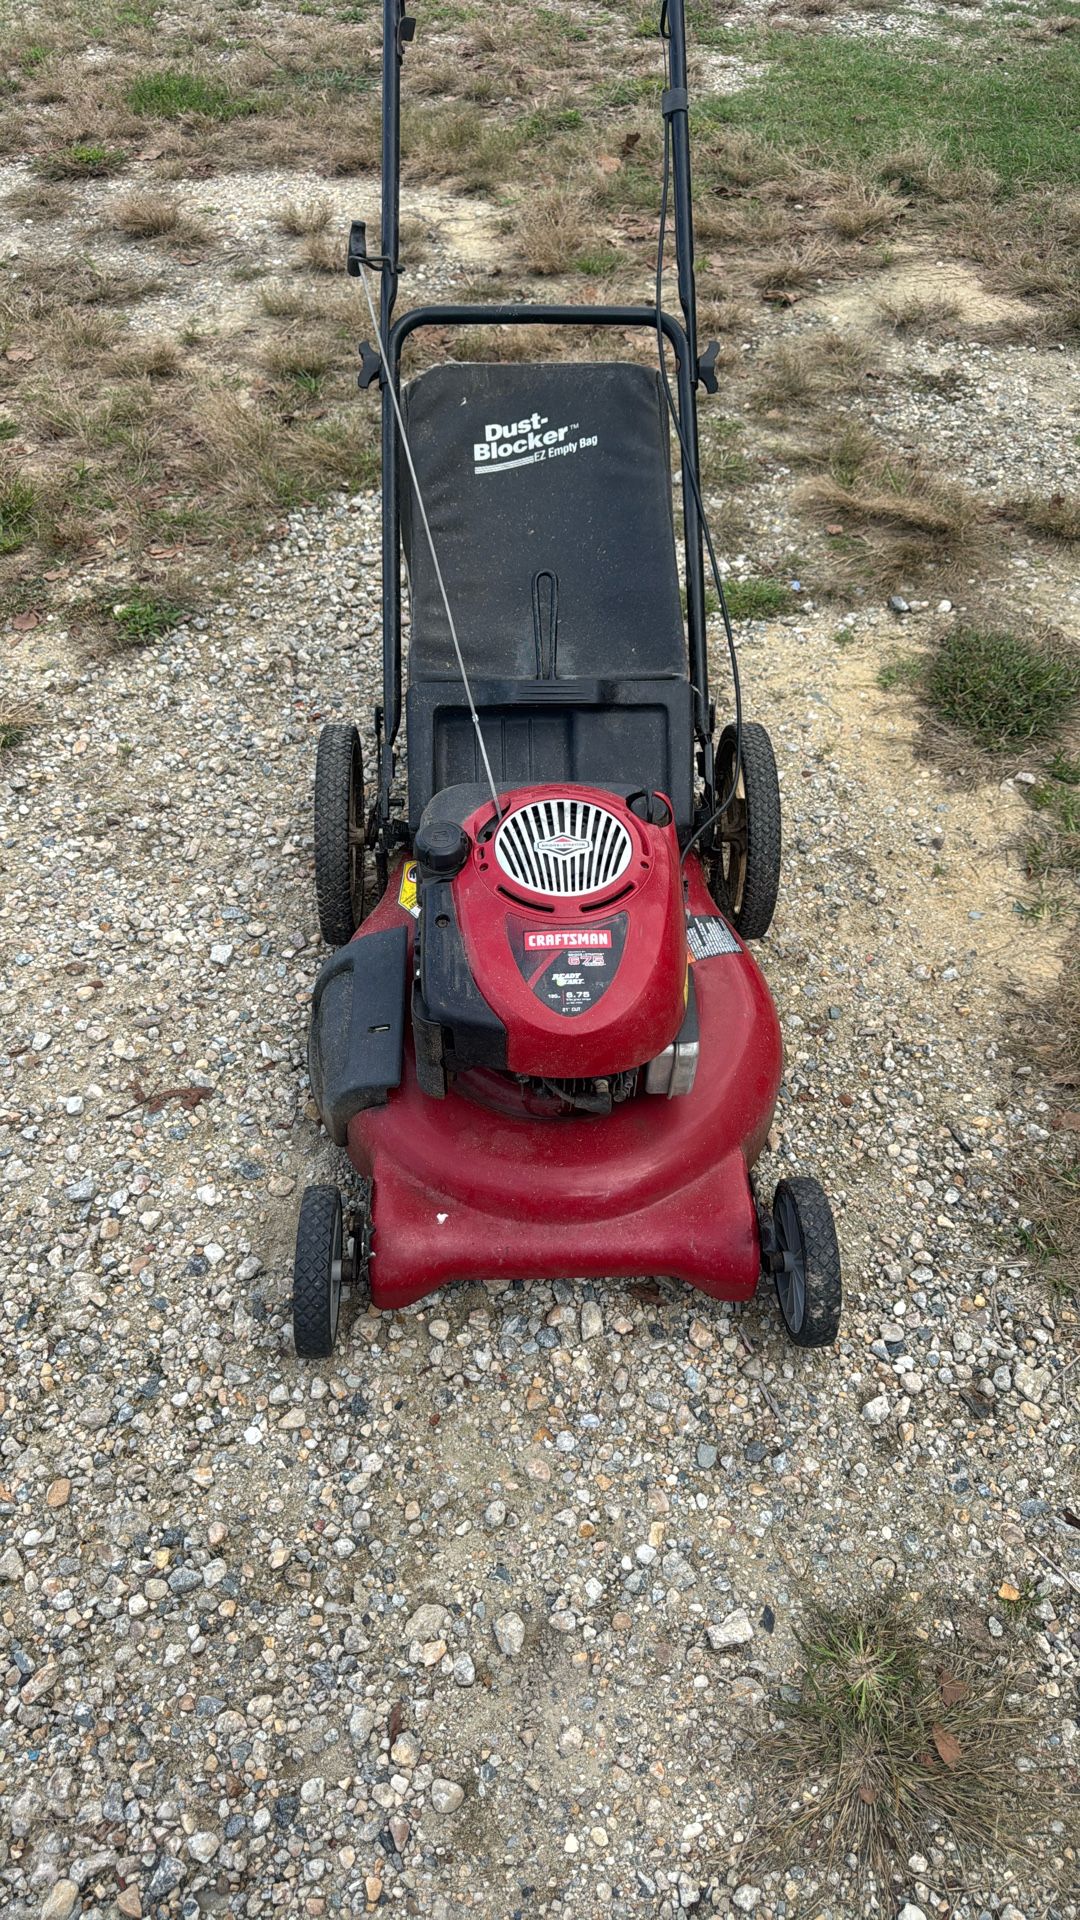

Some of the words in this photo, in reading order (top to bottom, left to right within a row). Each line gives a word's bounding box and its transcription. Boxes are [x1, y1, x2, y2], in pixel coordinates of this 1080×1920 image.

[485, 412, 548, 442] Dust-
[474, 426, 568, 461] Blocker
[534, 451, 546, 462] EZ
[548, 441, 577, 458] Empty
[579, 435, 598, 449] Bag
[528, 933, 608, 947] CRAFTSMAN
